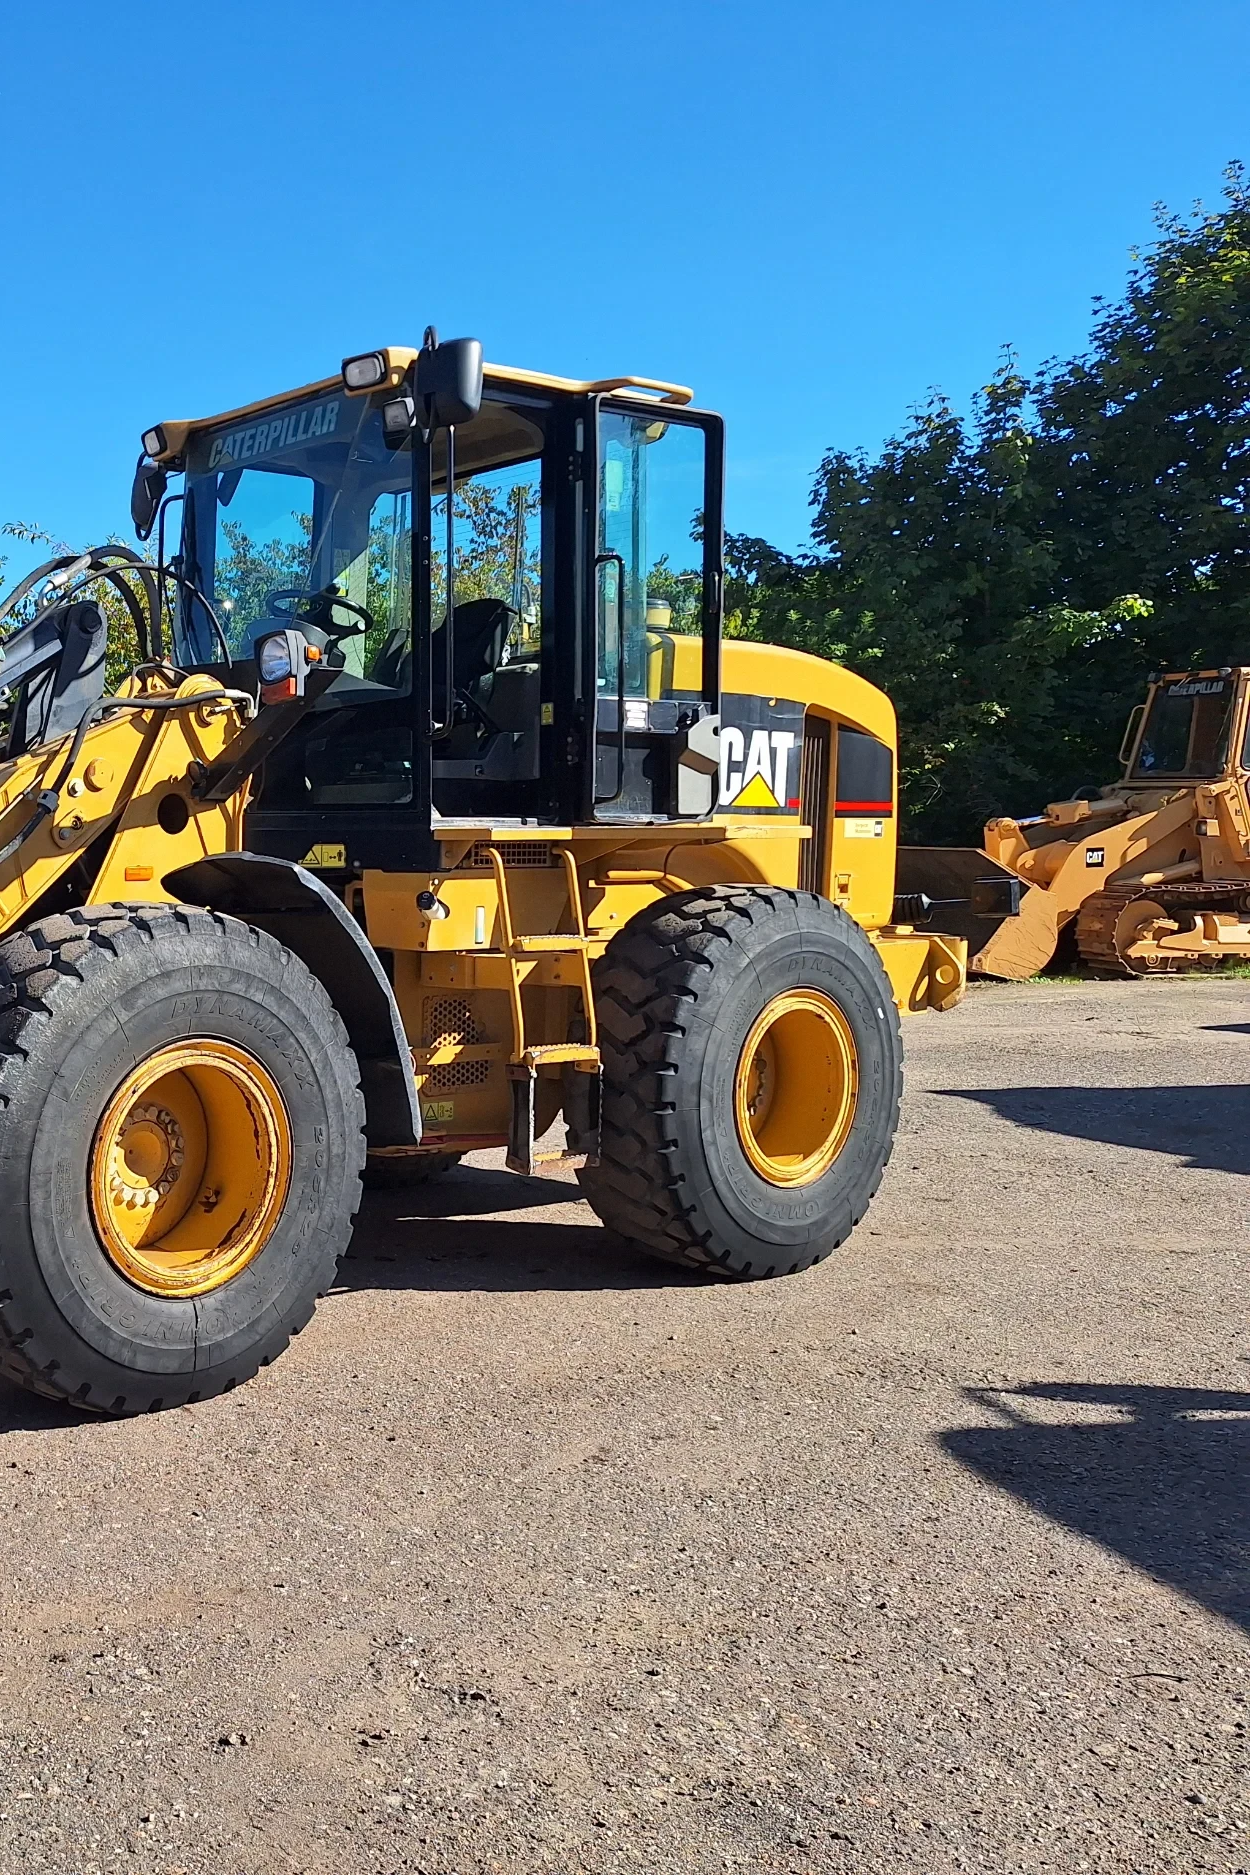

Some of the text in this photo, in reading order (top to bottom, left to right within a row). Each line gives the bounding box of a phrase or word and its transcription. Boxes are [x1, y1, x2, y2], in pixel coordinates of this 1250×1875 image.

[208, 400, 340, 469] CATERPILLAR
[717, 726, 795, 808] CAT
[1086, 850, 1105, 864] CAT
[170, 996, 316, 1090] DYNAMAXX
